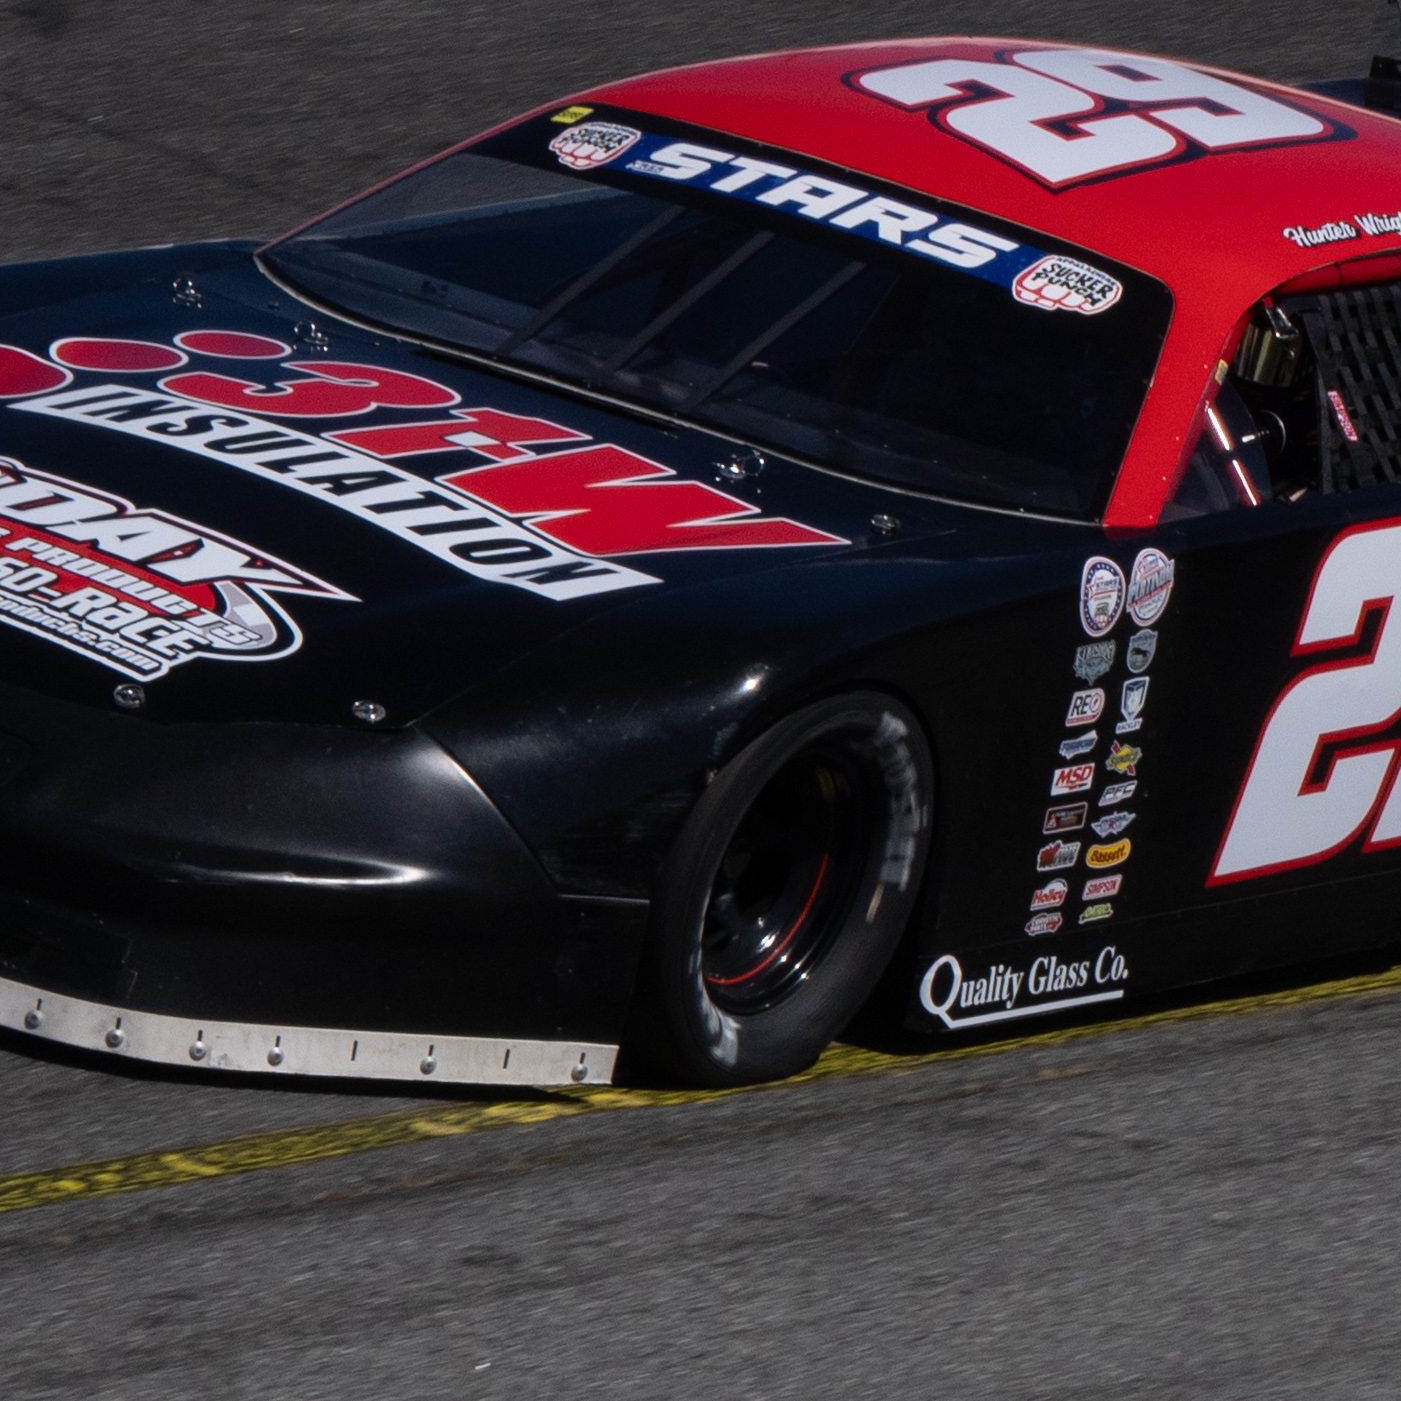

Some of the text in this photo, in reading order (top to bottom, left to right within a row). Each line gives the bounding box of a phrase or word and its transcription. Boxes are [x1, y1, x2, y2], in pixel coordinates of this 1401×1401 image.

[848, 47, 1332, 189] 29
[647, 142, 1020, 268] STARS
[1282, 221, 1358, 247] Hunter
[1031, 271, 1103, 307] PUNCH
[1042, 263, 1114, 300] SUCKER
[40, 387, 610, 590] INSULATION
[4, 536, 263, 646] PRODUCTS
[1055, 765, 1093, 787] MSD
[1103, 781, 1137, 799] PFC
[1033, 888, 1066, 904] Holley
[1085, 880, 1118, 896] SIMPSON
[919, 946, 1129, 1029] Quality Glass Co.
